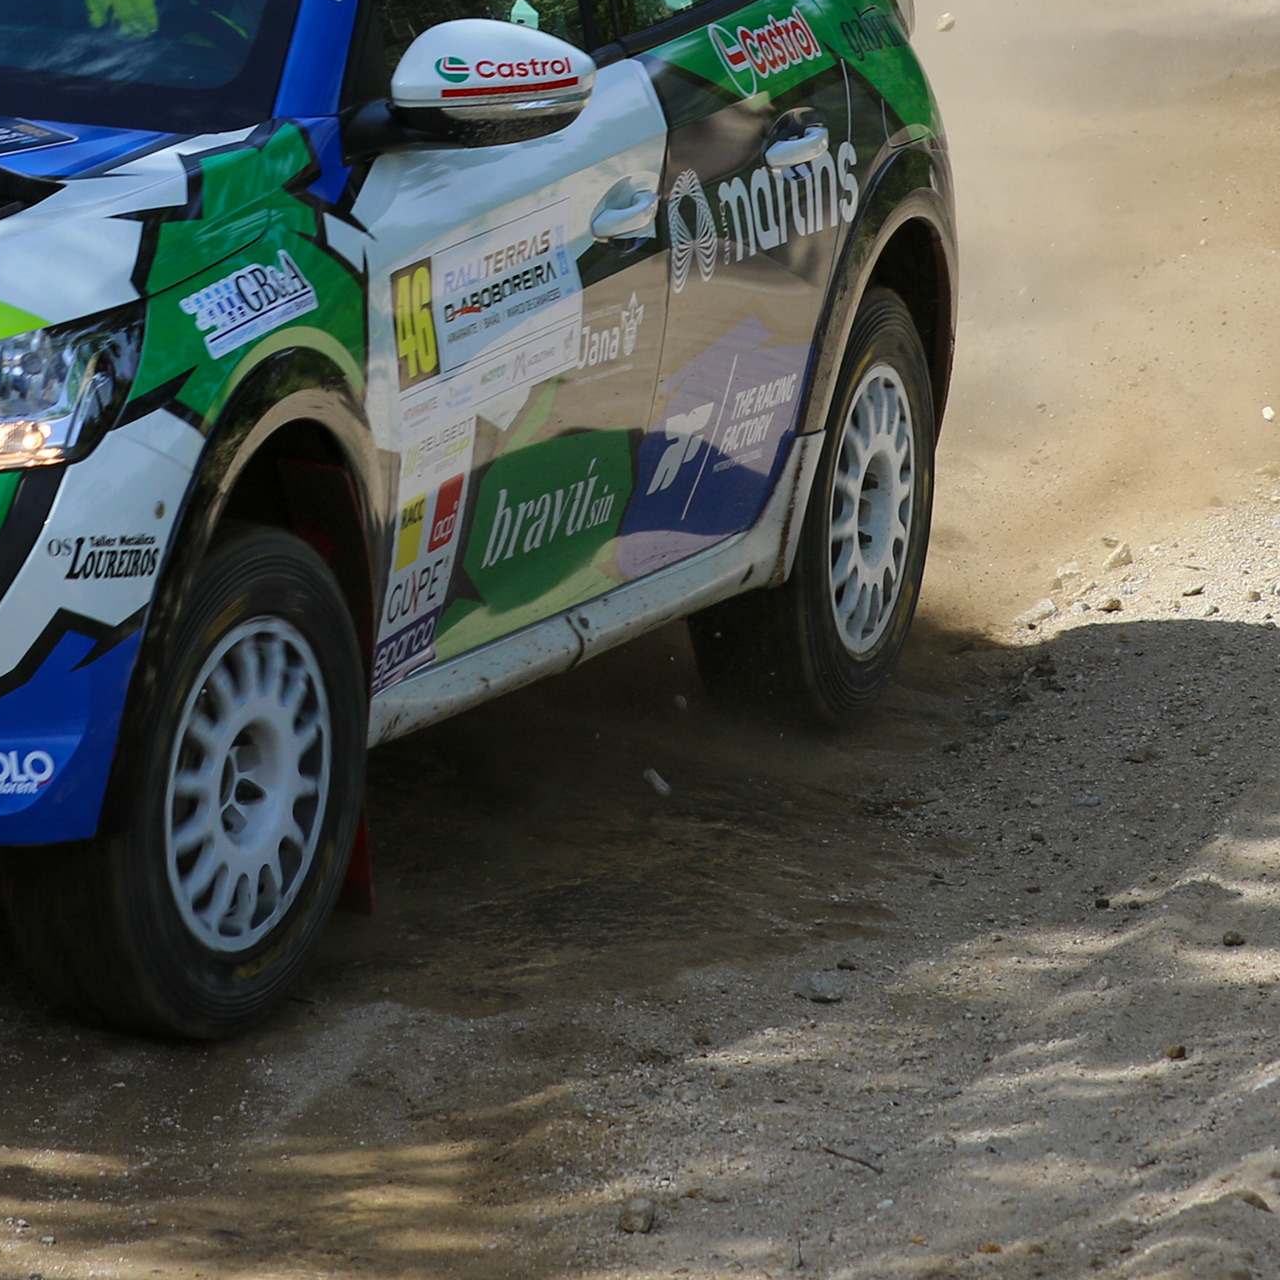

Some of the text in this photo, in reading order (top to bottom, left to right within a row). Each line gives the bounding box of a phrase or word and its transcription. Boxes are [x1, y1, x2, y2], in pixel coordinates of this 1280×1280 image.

[476, 56, 572, 78] Castrol
[739, 8, 822, 77] Castrol
[443, 258, 482, 297] RALI
[482, 229, 550, 279] TERRAS
[396, 266, 438, 379] 46
[731, 373, 797, 420] THE RACING
[718, 412, 775, 456] FACTORY
[481, 457, 599, 569] bravú
[586, 484, 615, 529] sin
[47, 538, 73, 557] OS
[375, 617, 436, 677] sparco
